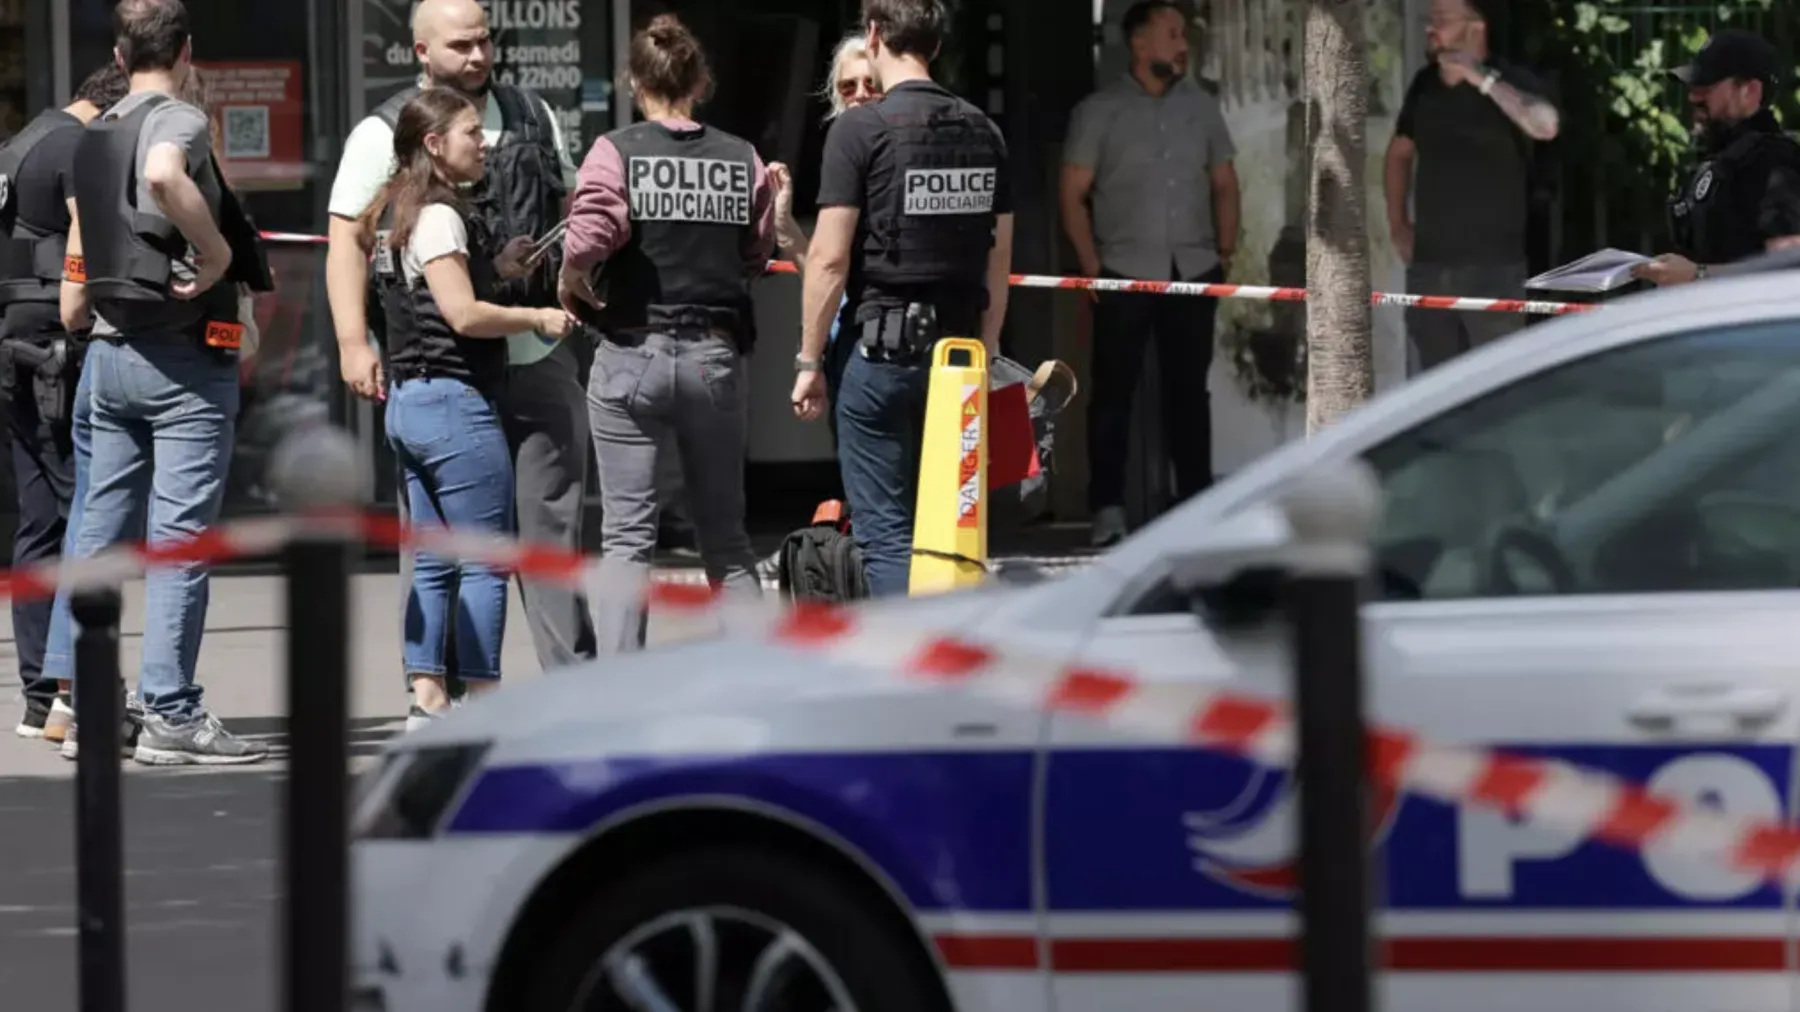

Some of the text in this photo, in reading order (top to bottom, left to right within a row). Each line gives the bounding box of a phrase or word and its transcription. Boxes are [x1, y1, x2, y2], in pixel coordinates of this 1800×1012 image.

[387, 43, 414, 65] du
[506, 41, 580, 63] samedi
[518, 66, 582, 88] 22h00
[632, 159, 747, 193] POLICE
[908, 173, 995, 194] POLICE
[632, 192, 747, 222] JUDICIAIRE
[960, 427, 978, 517] DANGER
